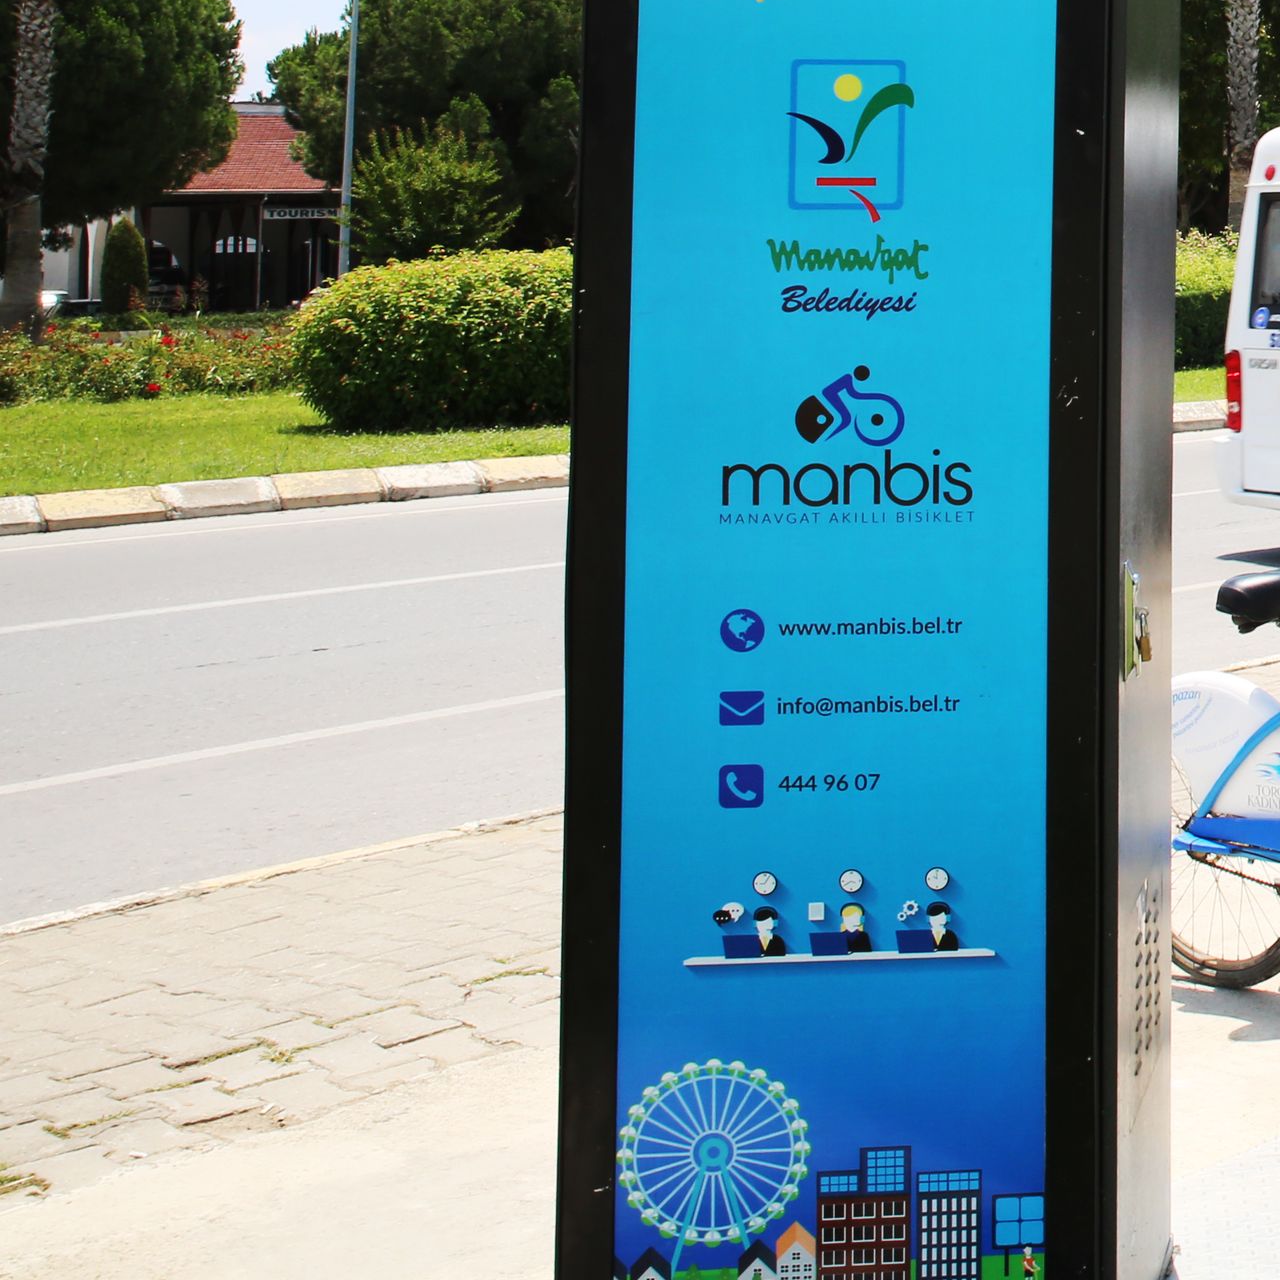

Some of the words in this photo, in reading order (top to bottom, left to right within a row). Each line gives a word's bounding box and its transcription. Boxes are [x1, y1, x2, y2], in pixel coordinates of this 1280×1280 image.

[766, 234, 929, 285] Manavgat
[781, 285, 918, 320] Belediyesi
[721, 449, 974, 508] manbis
[719, 512, 821, 525] MANAVGAT
[829, 512, 887, 524] AKILLI
[896, 509, 975, 523] BİSİKLET
[778, 617, 962, 636] www.manbis.bel.tr
[777, 695, 960, 717] info@manbis.bel.tr
[778, 775, 817, 792] 444
[823, 774, 849, 792] 96
[854, 773, 880, 791] 07
